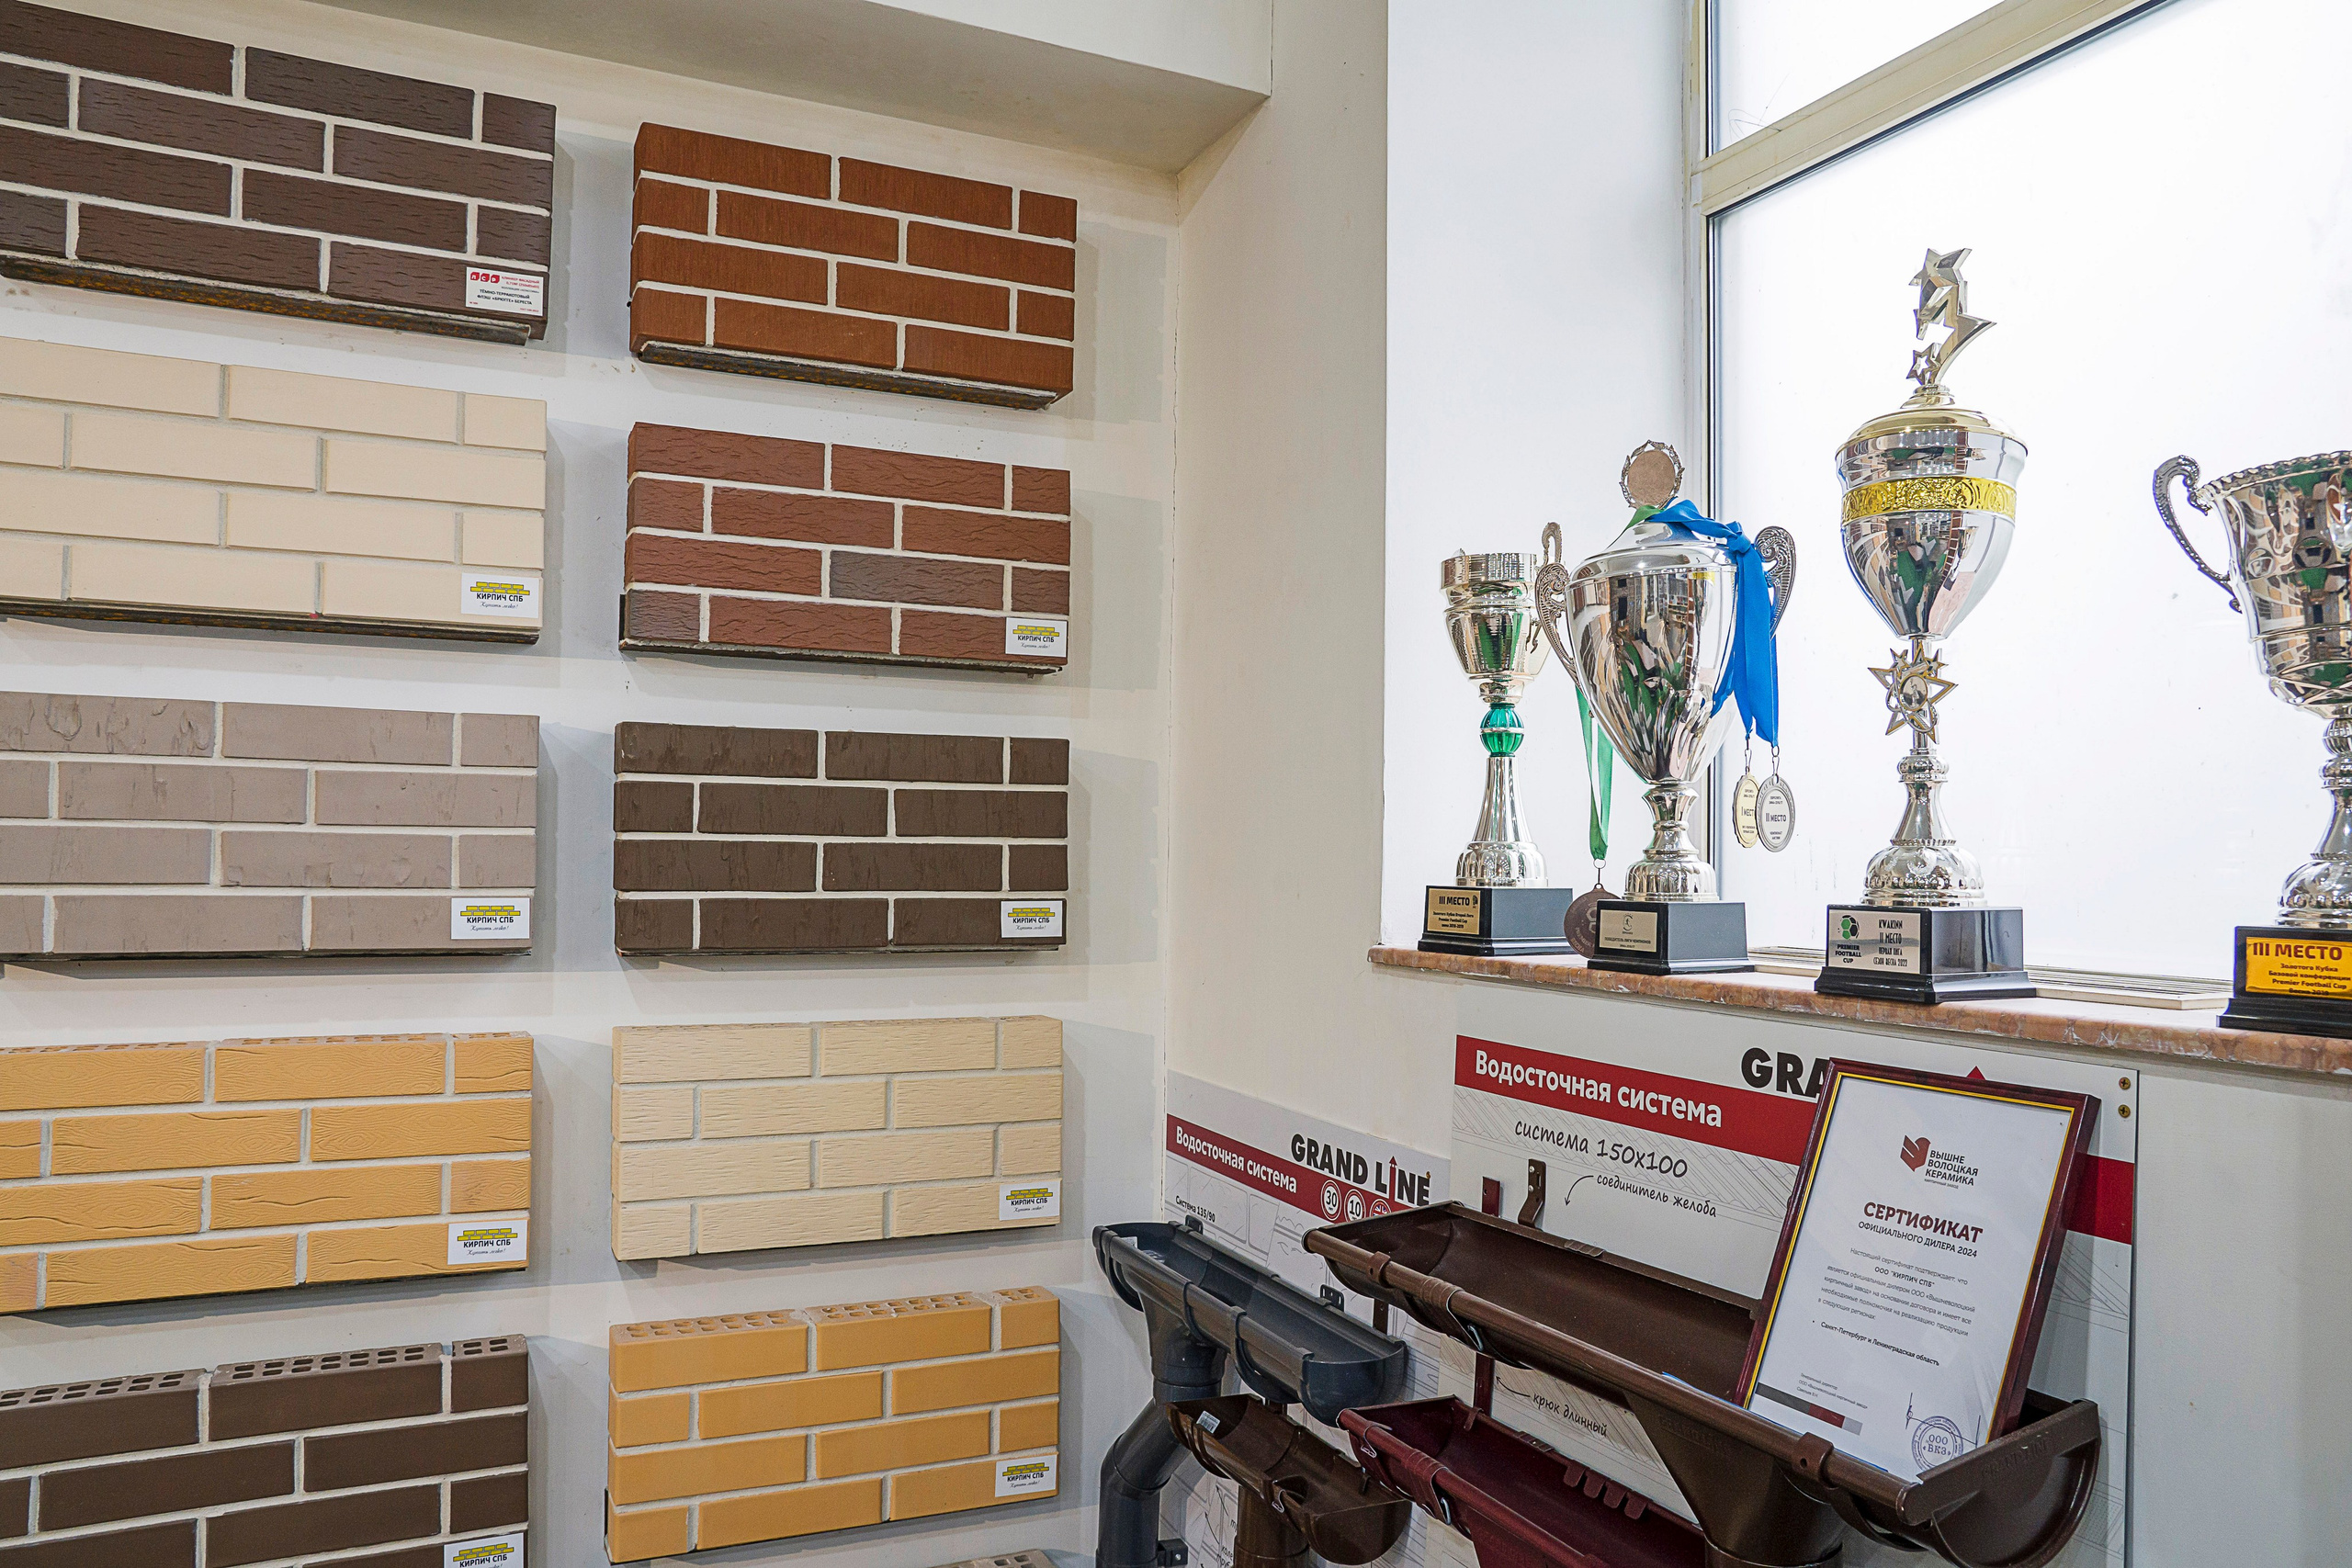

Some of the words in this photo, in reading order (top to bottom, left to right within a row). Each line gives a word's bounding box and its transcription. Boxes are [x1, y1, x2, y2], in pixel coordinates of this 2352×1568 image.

[477, 592, 506, 601] КИРПИЧ
[1447, 897, 1470, 906] МЕСТО
[1885, 933, 1902, 944] МЕСТО
[2254, 942, 2269, 956] III
[2275, 944, 2343, 961] МЕСТО
[2280, 963, 2313, 971] Золотого
[2300, 973, 2351, 981] конференции
[2301, 980, 2331, 988] Football
[1476, 1050, 1611, 1103] Водосточная
[1617, 1086, 1722, 1128] система
[1515, 1121, 1589, 1154] система
[1176, 1126, 1245, 1171] Водосточная
[1247, 1159, 1297, 1193] система
[1930, 1150, 1965, 1164] ВЫШНЕ
[1291, 1134, 1368, 1185] GRAND
[1375, 1156, 1430, 1206] LINE
[1926, 1168, 1974, 1186] КЕРАМИКА
[1928, 1159, 1979, 1177] ВОЛОЦКАЯ
[1326, 1190, 1337, 1207] 30
[1597, 1173, 1668, 1202] соединитель
[1673, 1195, 1716, 1217] желоба
[1176, 1195, 1196, 1213] Система
[1196, 1206, 1216, 1223] 135/90
[1350, 1200, 1361, 1217] 10
[1864, 1201, 1984, 1243] СЕРТИФИКАТ
[463, 1240, 493, 1248] КИРПИЧ
[1859, 1221, 1923, 1244] ОФИЦИАЛЬНОГО
[1924, 1237, 1955, 1252] ДИЛЕРА
[1957, 1247, 1977, 1258] 2024
[1850, 1247, 1881, 1260] Настоящий
[1882, 1258, 1914, 1269] сертификат
[1850, 1272, 1886, 1287] официальным
[1911, 1289, 1925, 1298] ООО
[1874, 1267, 1889, 1275] ООО
[1892, 1270, 1918, 1283] "КИРПИЧ
[1919, 1279, 1935, 1287] СПБ"
[1821, 1287, 1858, 1302] необходимые
[1860, 1299, 1893, 1313] полномочия
[1901, 1312, 1935, 1326] реализацию
[1936, 1323, 1969, 1337] продукции
[1881, 1293, 1909, 1305] основании
[1910, 1303, 1937, 1314] договора
[1942, 1312, 1961, 1321] имеет
[1821, 1322, 1867, 1342] Санкт-Петербург
[1872, 1339, 1915, 1358] Ленинградская
[1916, 1353, 1939, 1366] область
[1533, 1393, 1559, 1414] крюк
[1564, 1404, 1607, 1437] длинный
[1929, 1434, 1948, 1445] ООО
[459, 1557, 491, 1568] КИРПИЧ
[492, 1554, 507, 1562] СПБ
